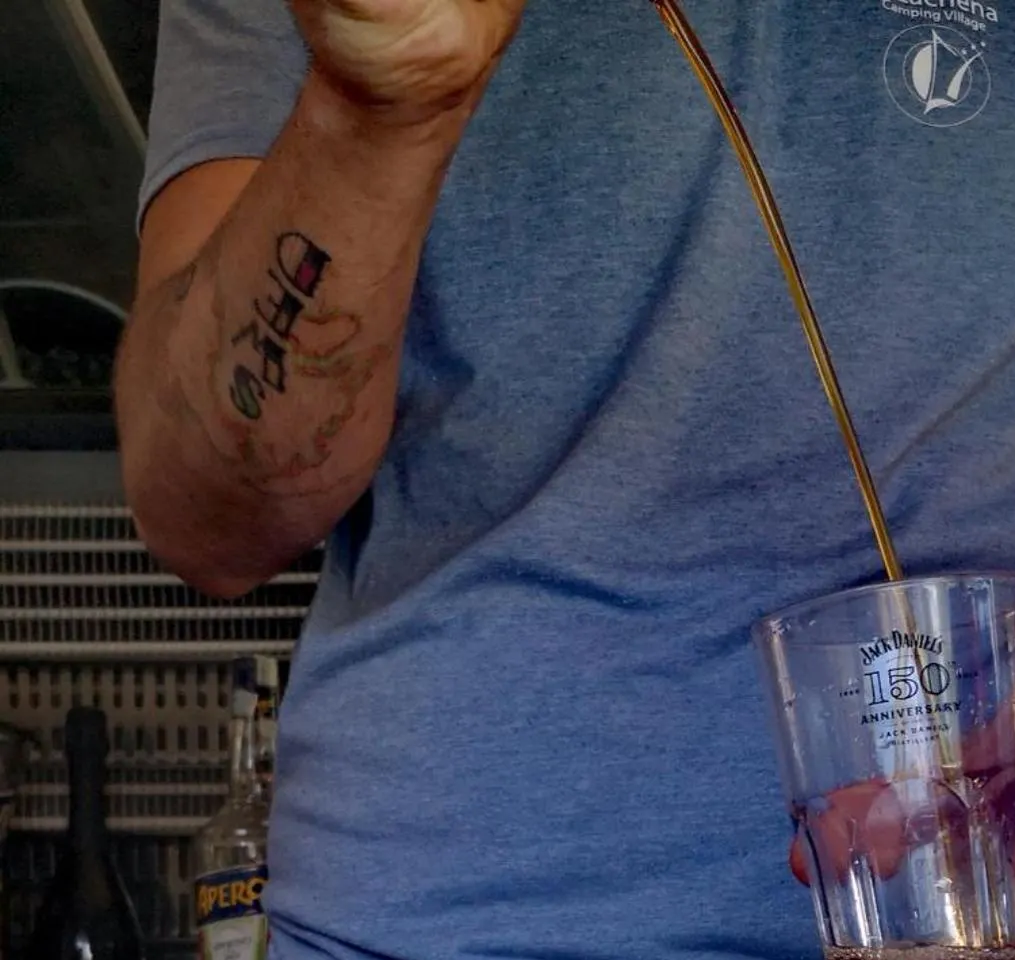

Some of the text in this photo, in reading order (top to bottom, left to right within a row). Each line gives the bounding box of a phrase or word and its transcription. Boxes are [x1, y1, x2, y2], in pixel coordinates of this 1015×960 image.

[943, 9, 987, 31] Village
[864, 662, 950, 706] 150
[860, 700, 963, 725] ANNIVERSARY
